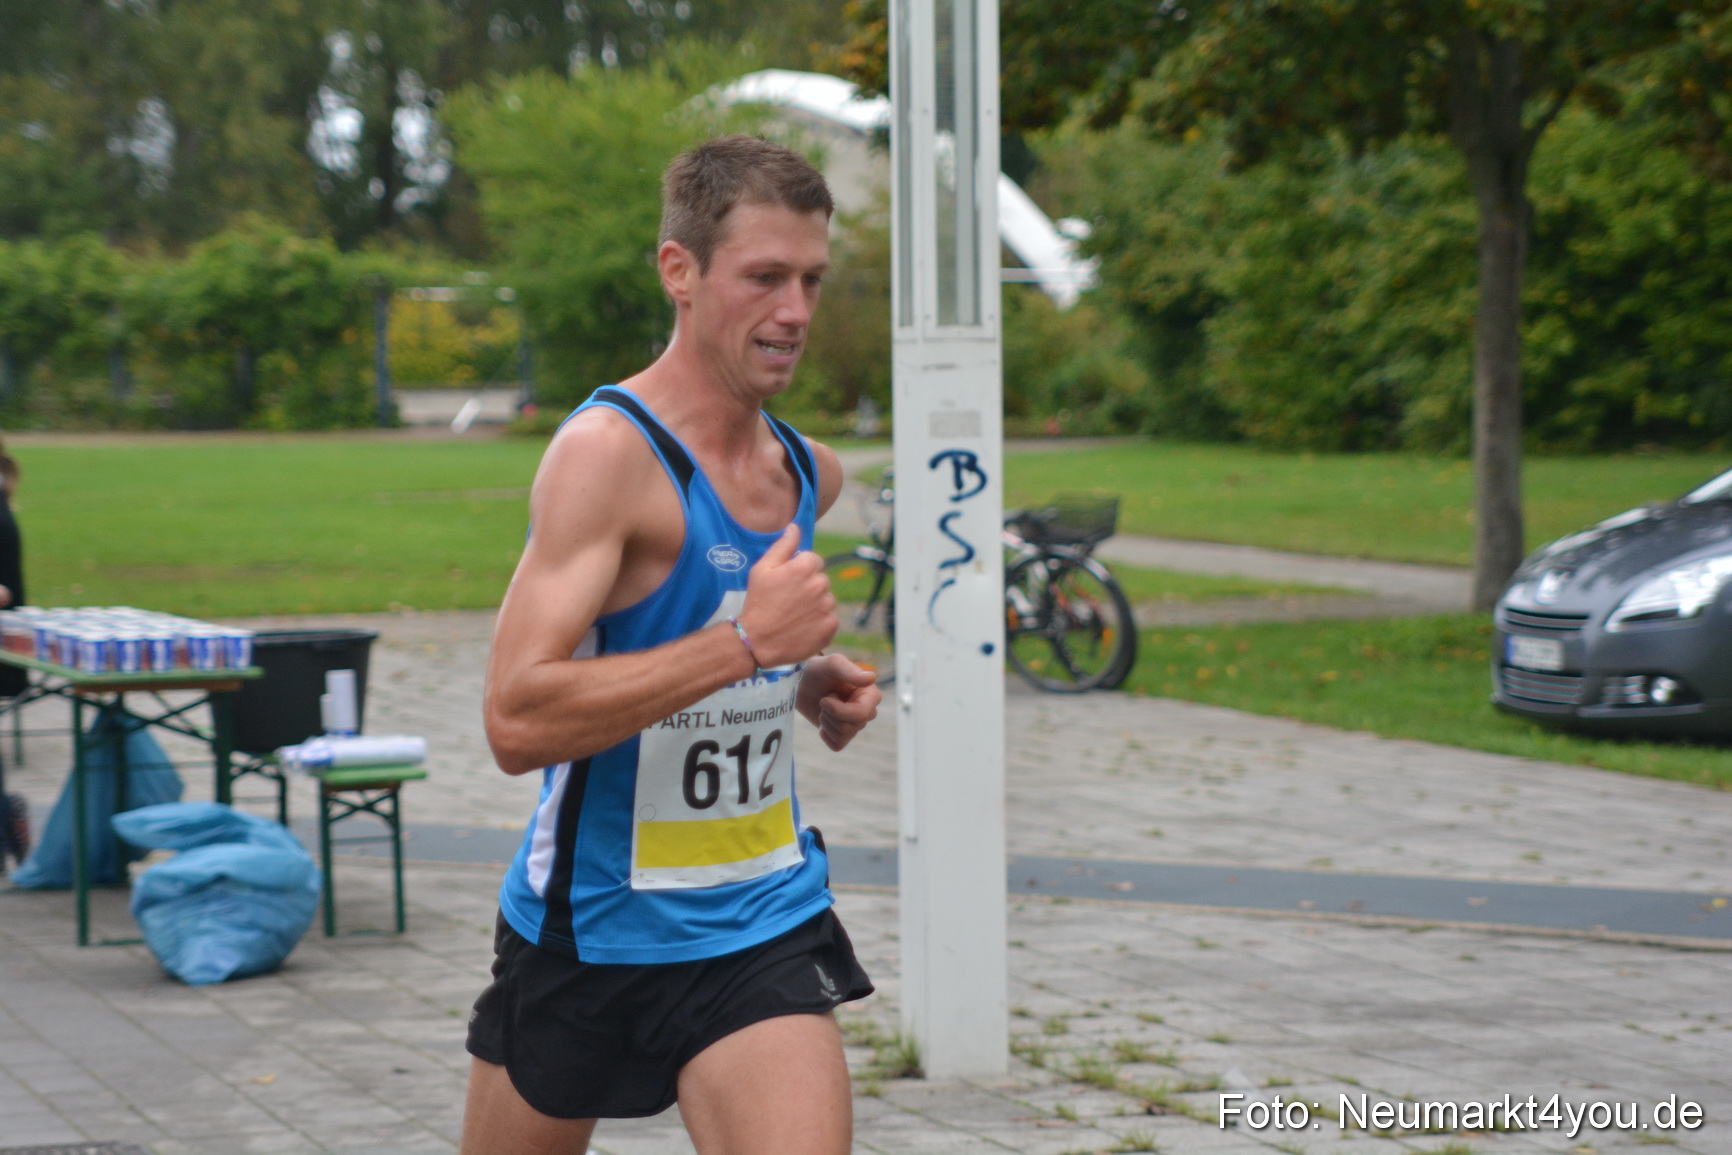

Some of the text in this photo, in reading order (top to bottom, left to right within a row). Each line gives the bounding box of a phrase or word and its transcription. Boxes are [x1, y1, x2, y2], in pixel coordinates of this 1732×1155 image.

[648, 710, 716, 730] ARTL
[720, 699, 788, 726] Neumarkt
[682, 729, 782, 810] 612
